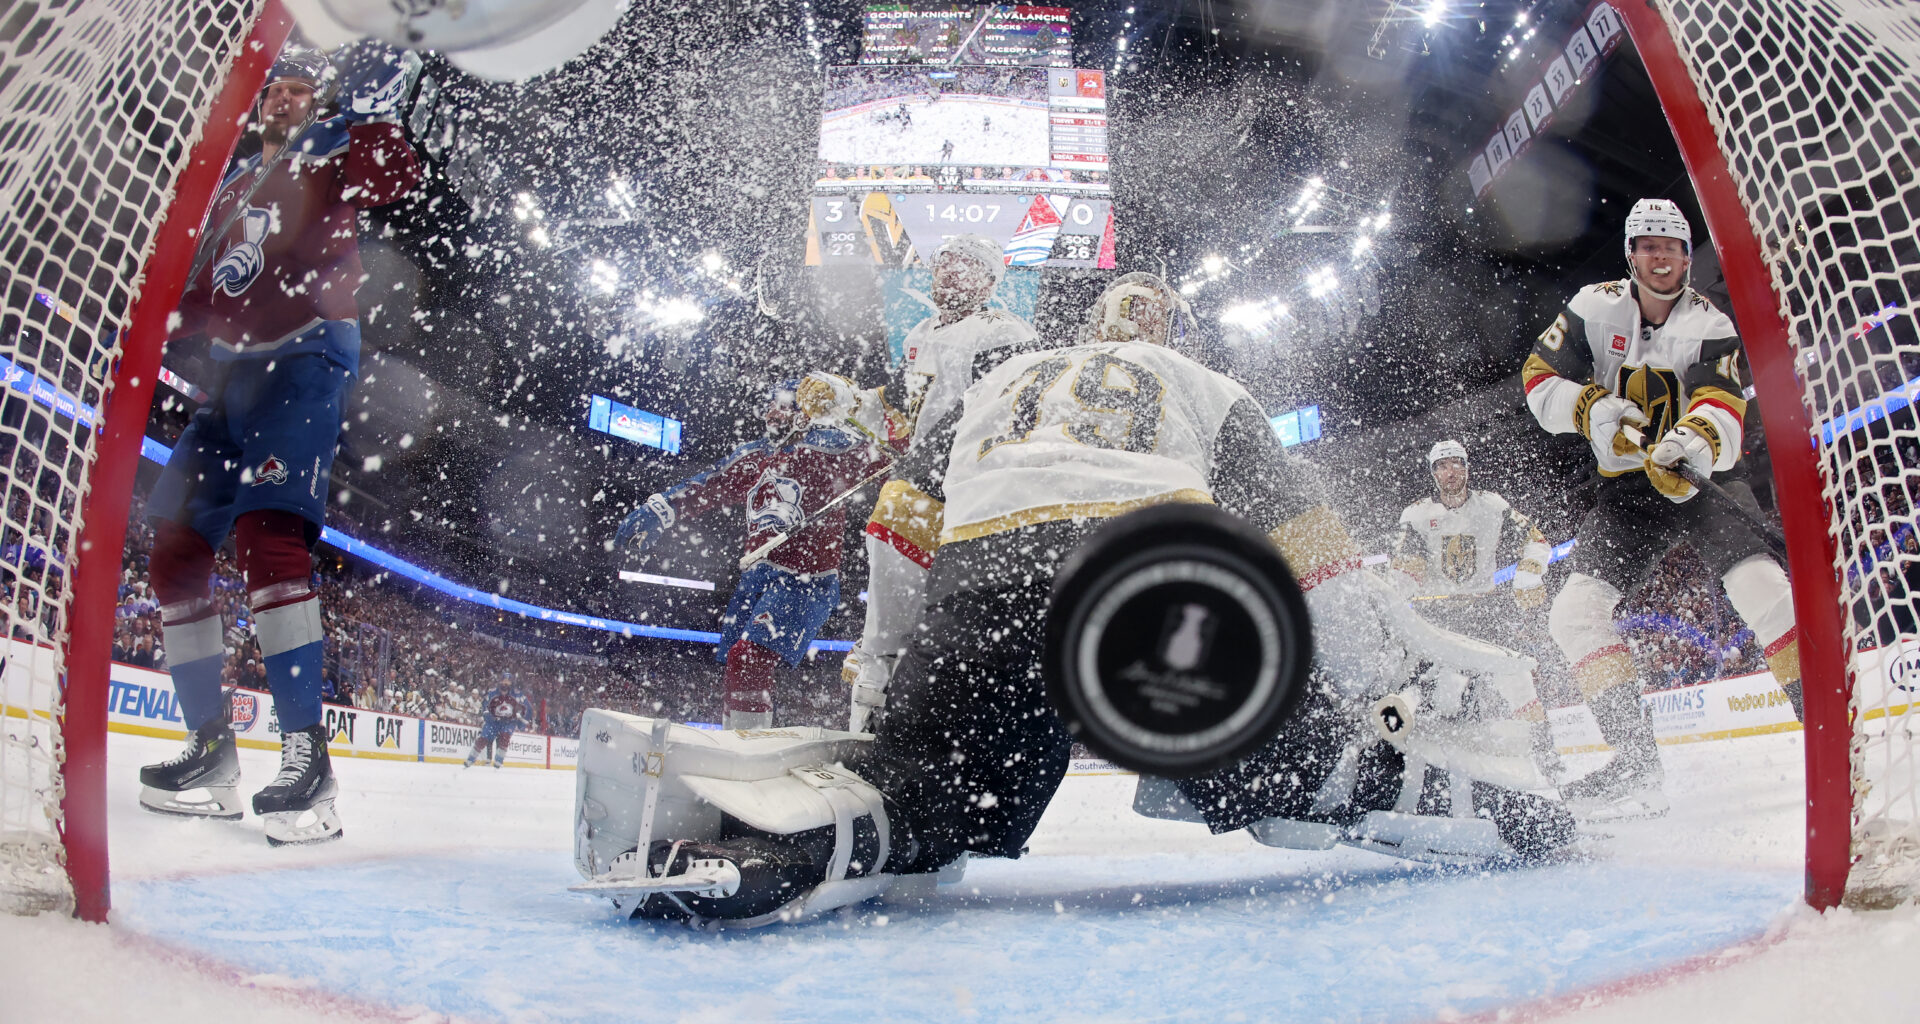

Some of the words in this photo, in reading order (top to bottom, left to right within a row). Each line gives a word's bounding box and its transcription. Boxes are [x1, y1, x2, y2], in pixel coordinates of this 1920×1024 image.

[870, 11, 918, 19] GOLDEN
[921, 11, 972, 19] KNIGHTS
[993, 12, 1068, 22] AVALANCHE
[825, 201, 844, 222] 3
[925, 204, 1001, 223] 14:07
[831, 233, 856, 242] SOG
[1065, 235, 1091, 245] SOG
[1066, 246, 1090, 259] 26
[325, 708, 357, 745] CAT
[375, 716, 403, 749] CAT
